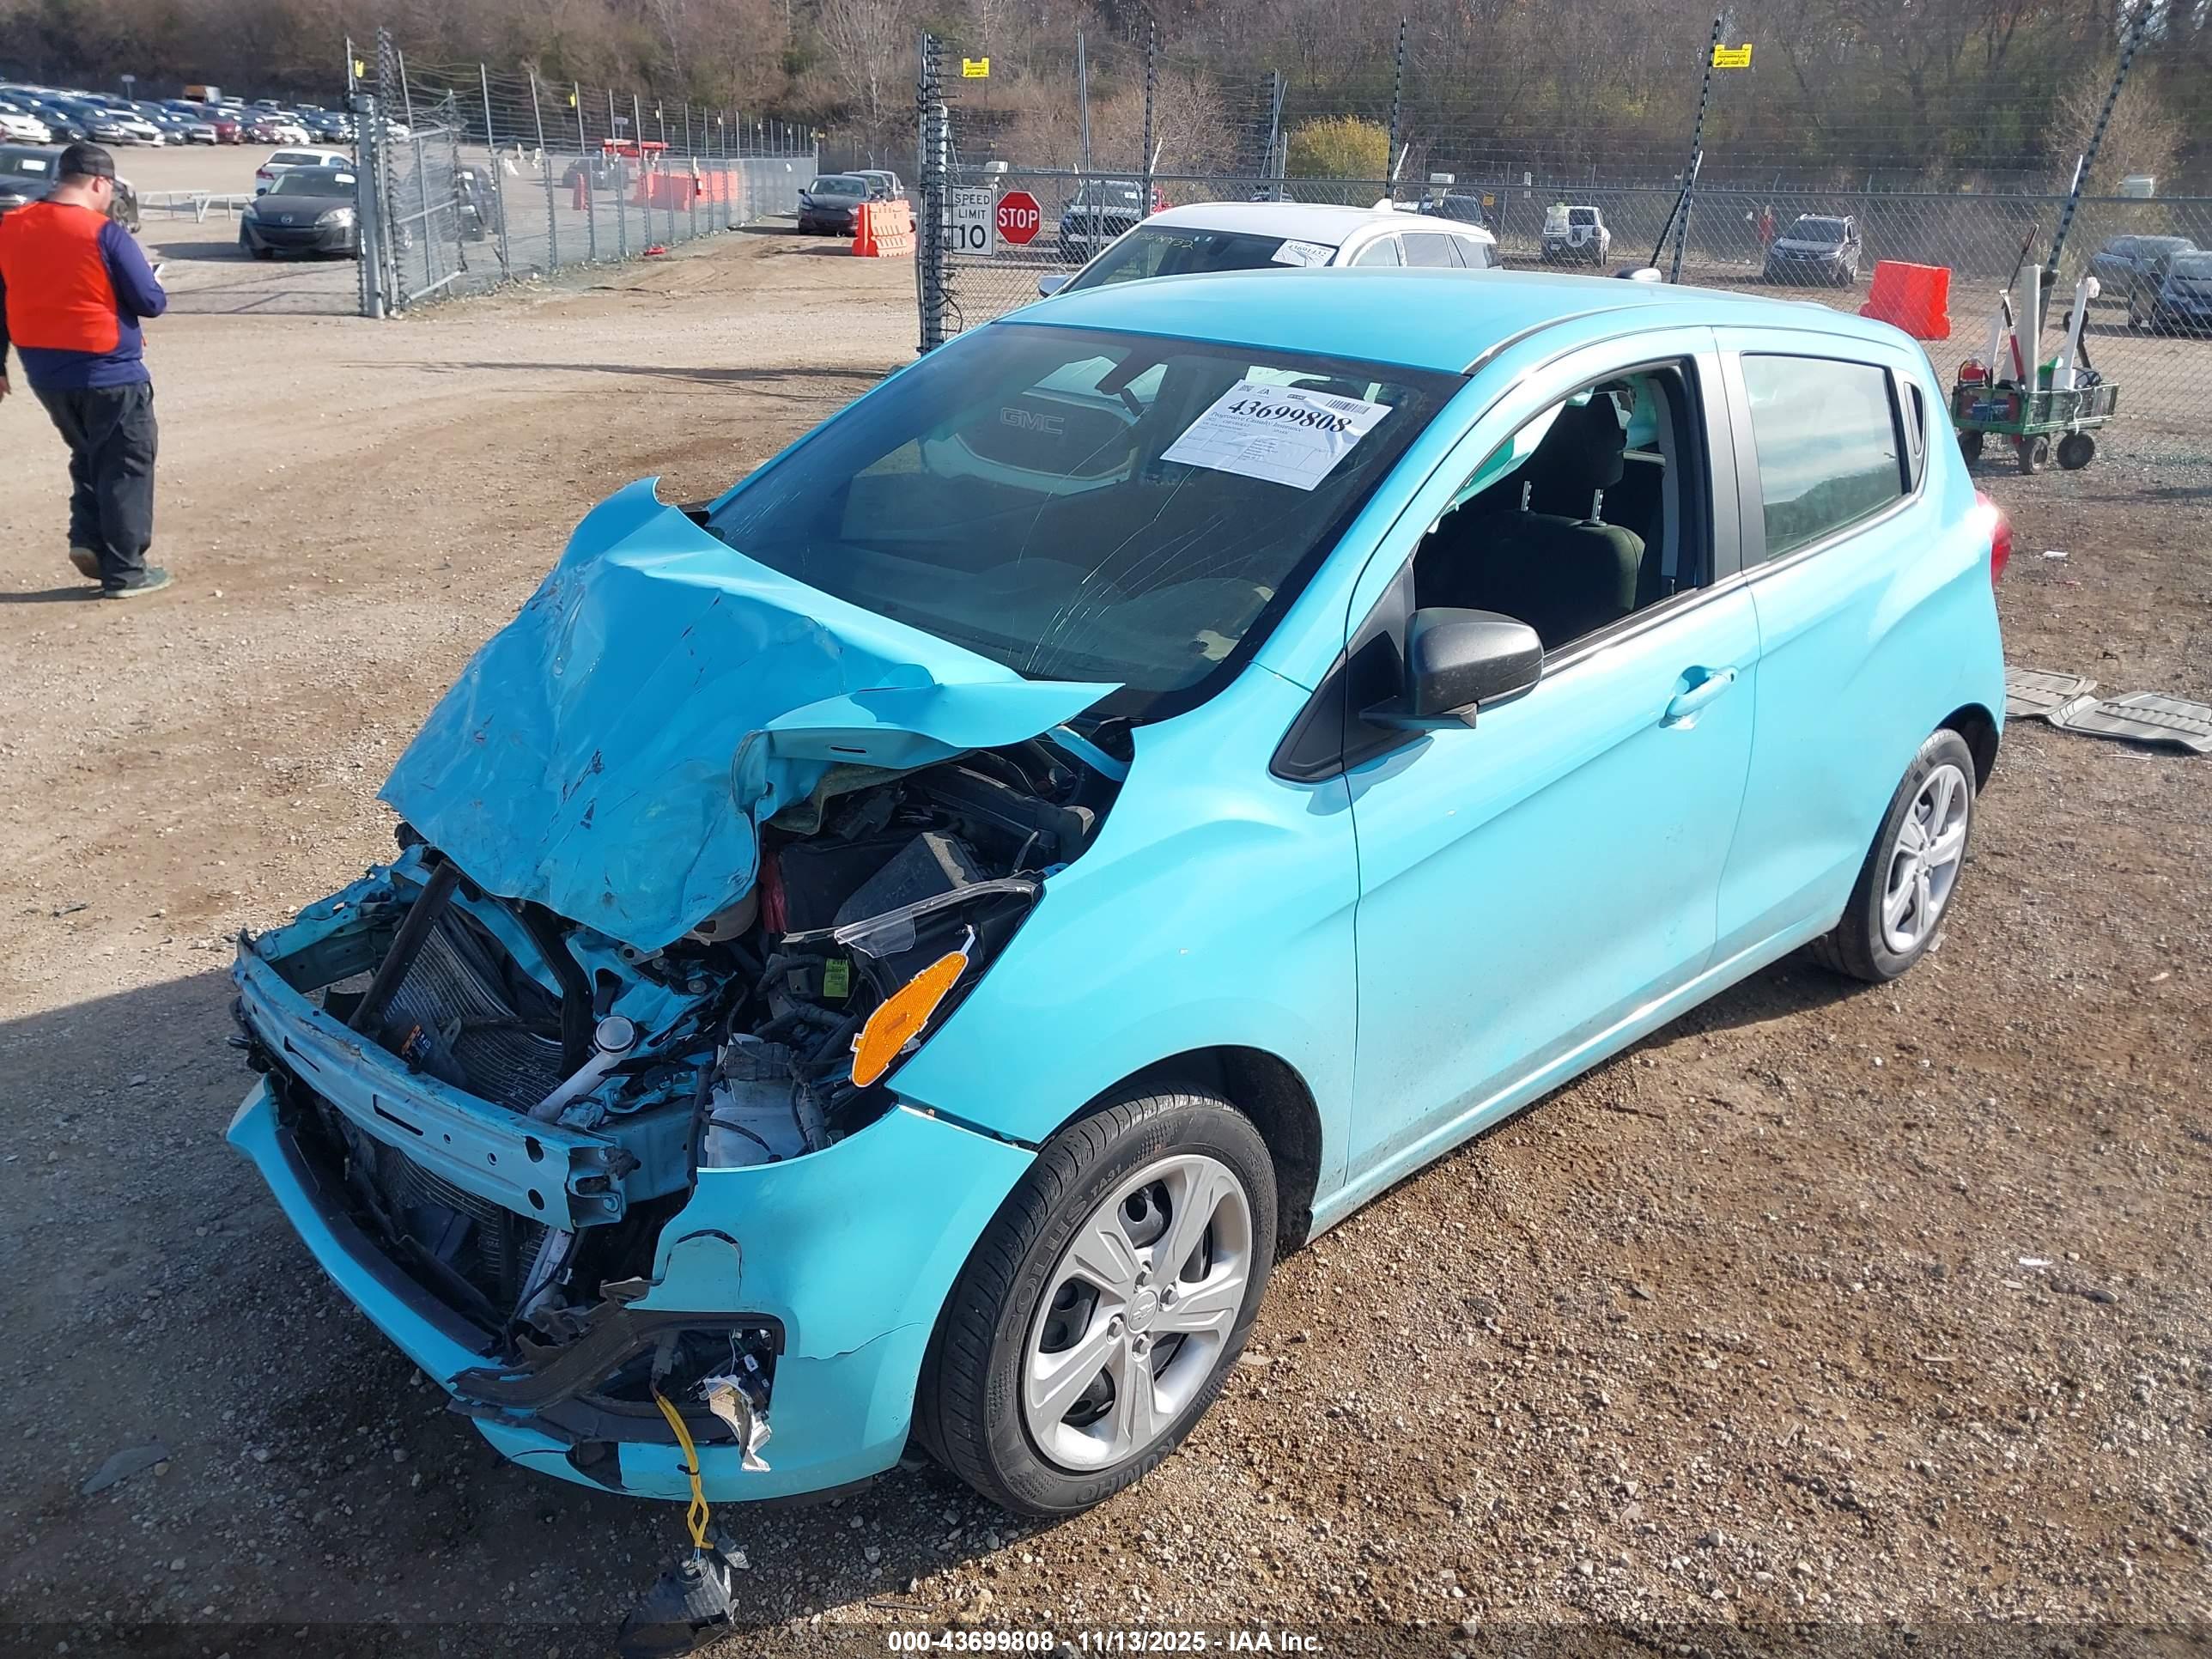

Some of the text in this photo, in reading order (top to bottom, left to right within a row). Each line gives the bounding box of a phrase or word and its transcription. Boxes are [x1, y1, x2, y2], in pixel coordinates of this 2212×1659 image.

[955, 194, 990, 205] SPEED
[958, 209, 987, 220] LIMIT
[998, 207, 1038, 228] STOP
[959, 224, 986, 249] 10
[1000, 407, 1065, 434] GMC
[1228, 399, 1352, 432] 43699808
[1273, 422, 1304, 432] Insurance
[1076, 1437, 1176, 1504] KUMHO
